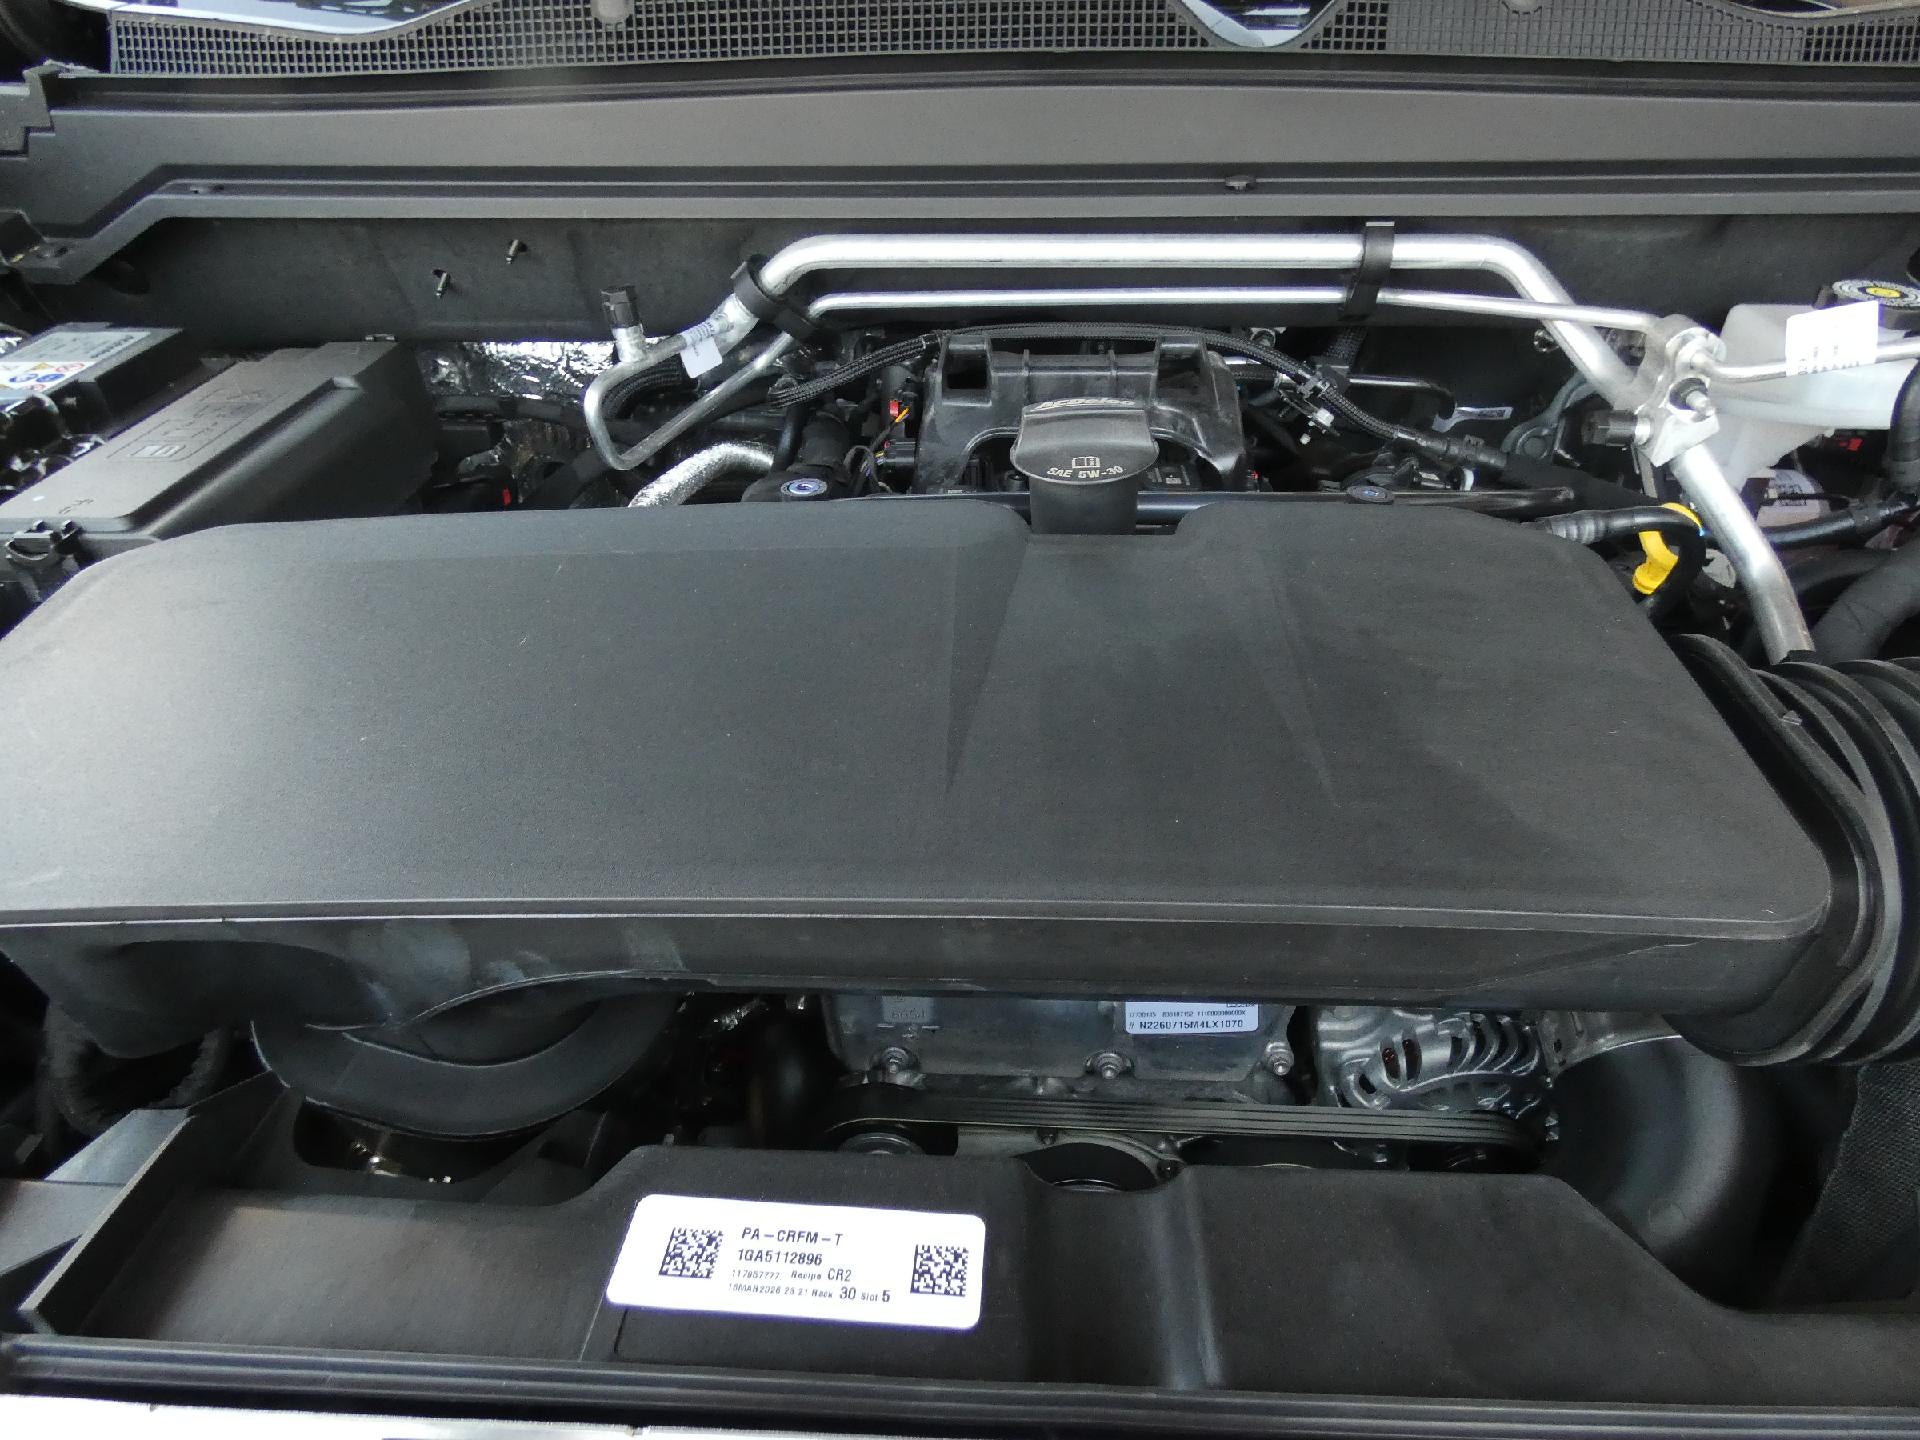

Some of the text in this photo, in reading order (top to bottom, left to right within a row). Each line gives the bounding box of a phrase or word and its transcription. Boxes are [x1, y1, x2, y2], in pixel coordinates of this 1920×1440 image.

[1047, 465, 1123, 478] SAE 5W-30
[827, 1267, 852, 1282] CR2
[839, 1286, 856, 1300] 30
[861, 1291, 879, 1302] Slot
[882, 1289, 891, 1303] 5
